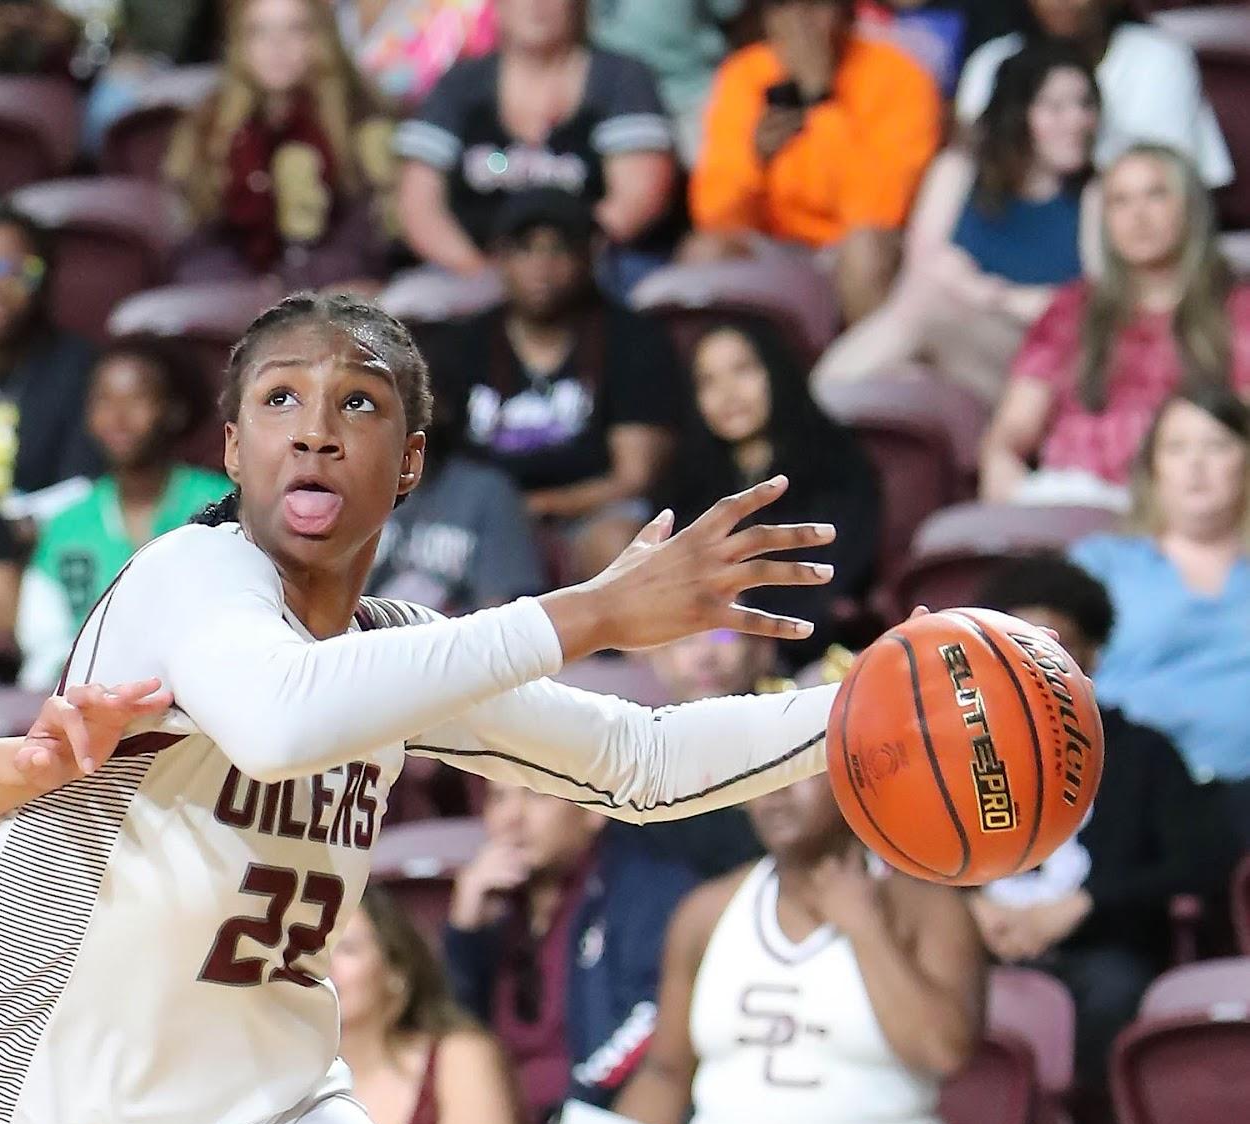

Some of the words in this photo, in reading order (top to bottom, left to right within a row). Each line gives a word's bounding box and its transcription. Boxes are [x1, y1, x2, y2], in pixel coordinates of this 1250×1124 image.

[937, 641, 1001, 772] ELITE
[980, 774, 1012, 832] PRO
[1007, 633, 1092, 807] Baden
[213, 760, 382, 850] OILERS
[196, 861, 346, 989] 22
